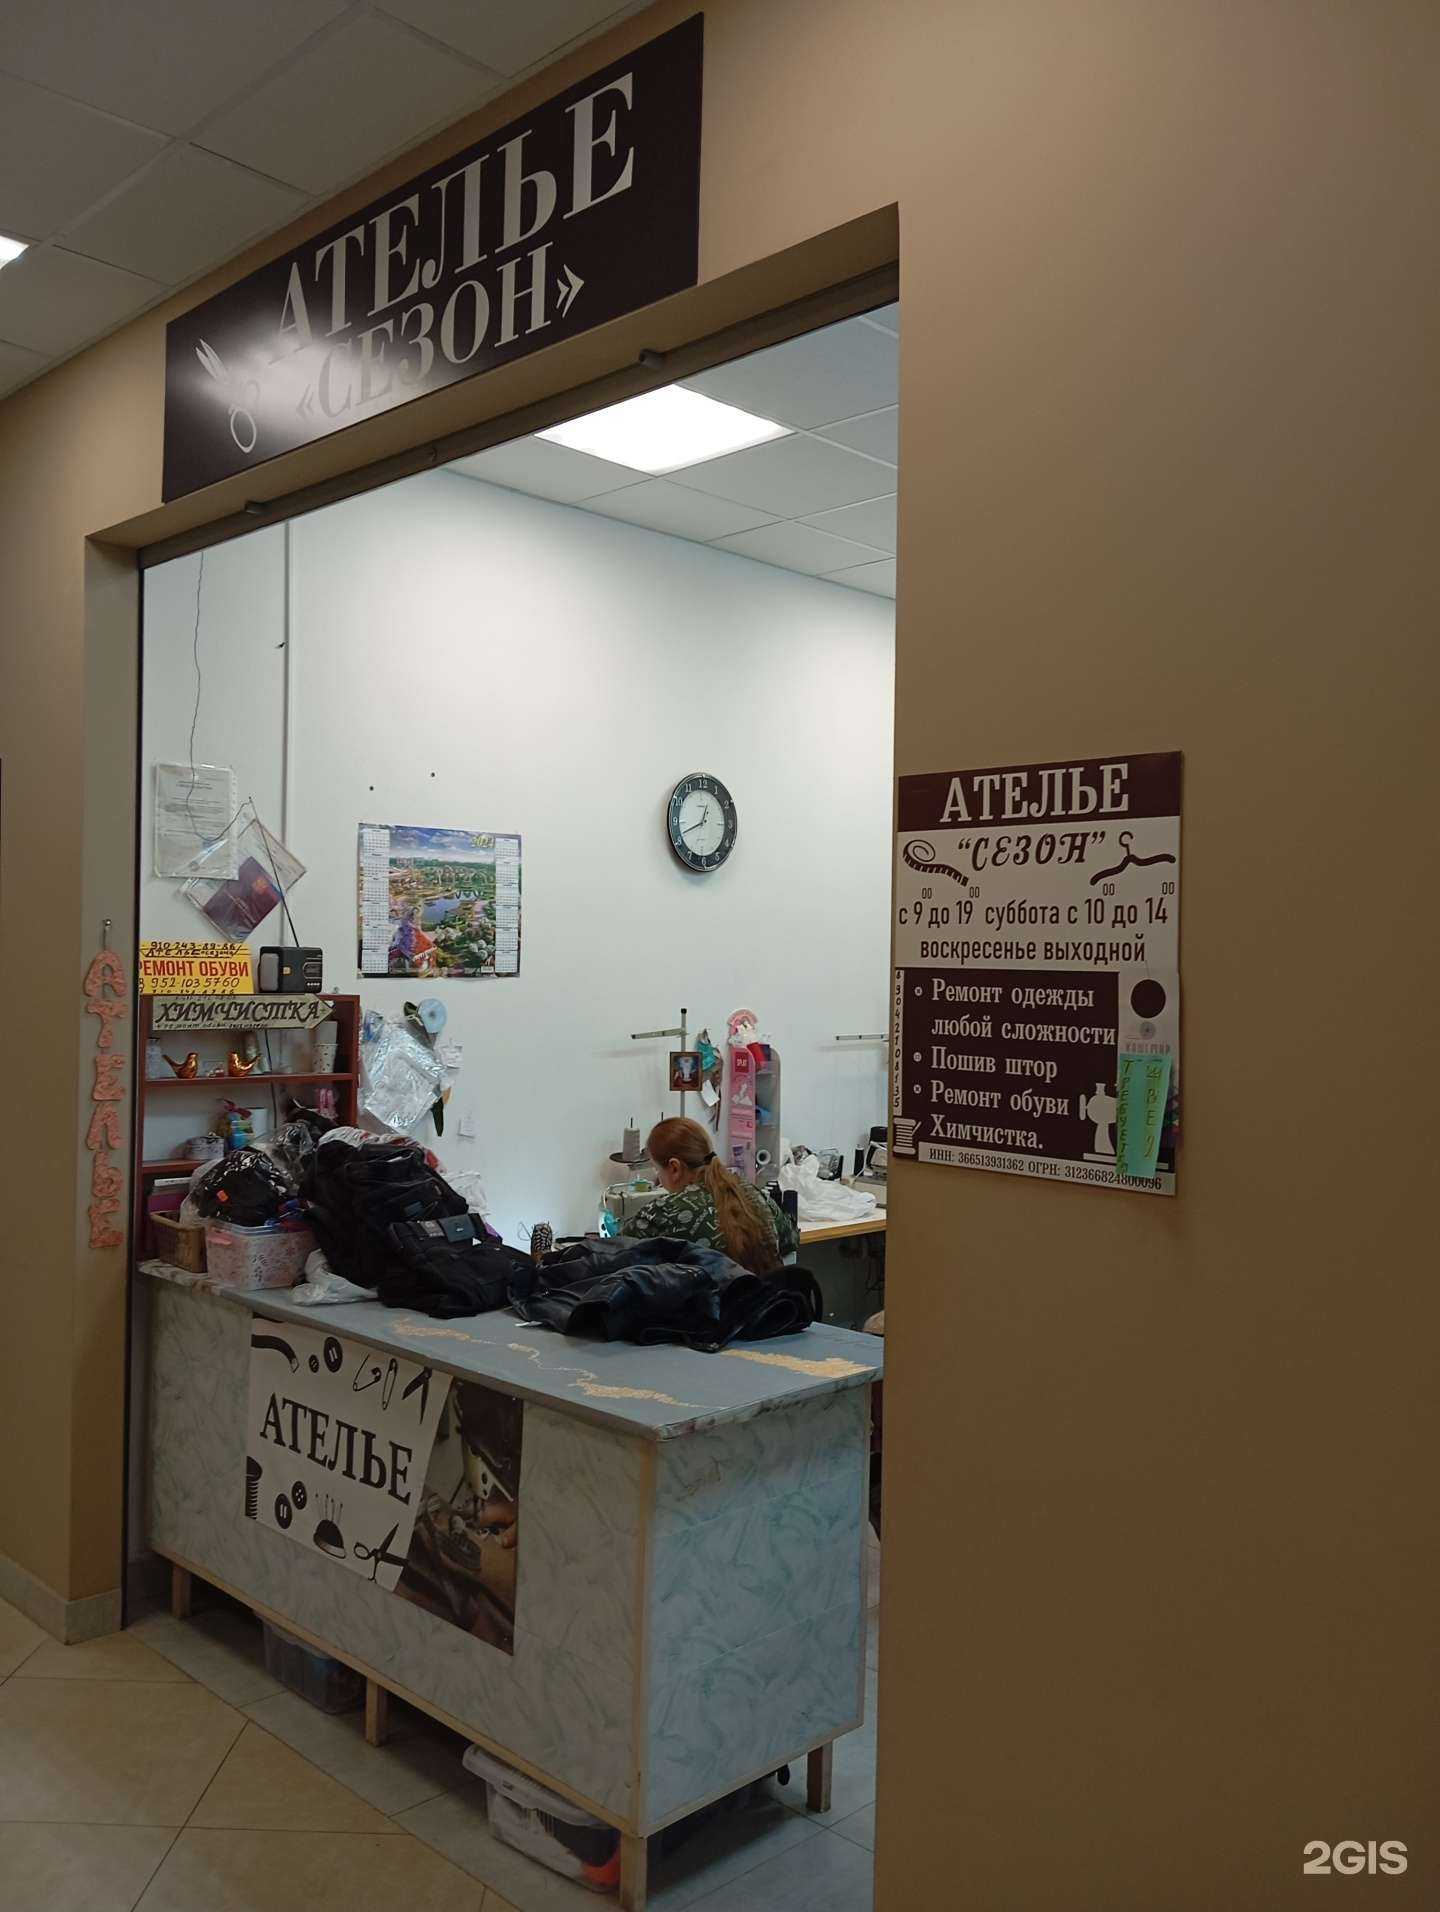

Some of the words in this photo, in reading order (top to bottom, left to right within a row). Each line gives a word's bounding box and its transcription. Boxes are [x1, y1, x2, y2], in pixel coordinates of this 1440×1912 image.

[267, 72, 635, 365] АТЕЛЬЕ
[296, 241, 585, 422] «СЕЗОН»
[940, 763, 1129, 822] АТЕЛЬЕ
[899, 908, 908, 925] с
[914, 901, 923, 925] 9
[928, 907, 949, 929] до
[956, 901, 973, 925] 19
[985, 900, 1060, 931] суббота
[1067, 905, 1077, 924] с
[1085, 898, 1104, 924] 10
[1112, 904, 1137, 929] до
[1146, 898, 1168, 924] 14
[921, 940, 1037, 965] воскресенье
[1043, 933, 1145, 966] выходной
[200, 961, 249, 977] ОБУВИ
[932, 978, 1002, 1003] Ремонт
[1012, 986, 1095, 1011] одежды
[155, 1000, 320, 1024] ХИМЧИСТКА
[932, 1014, 992, 1038] любой
[1001, 1021, 1116, 1046] сложности
[931, 1046, 996, 1073] Пошив
[1005, 1058, 1058, 1083] штор
[931, 1080, 1002, 1108] Ремонт
[1010, 1089, 1069, 1118] обуви
[930, 1114, 1043, 1149] Химчистка.
[929, 1148, 955, 1163] ИНН:
[958, 1154, 1025, 1172] 366513931362
[1028, 1161, 1060, 1177] ОГРН:
[259, 1392, 413, 1505] АТЕЛЬЕ
